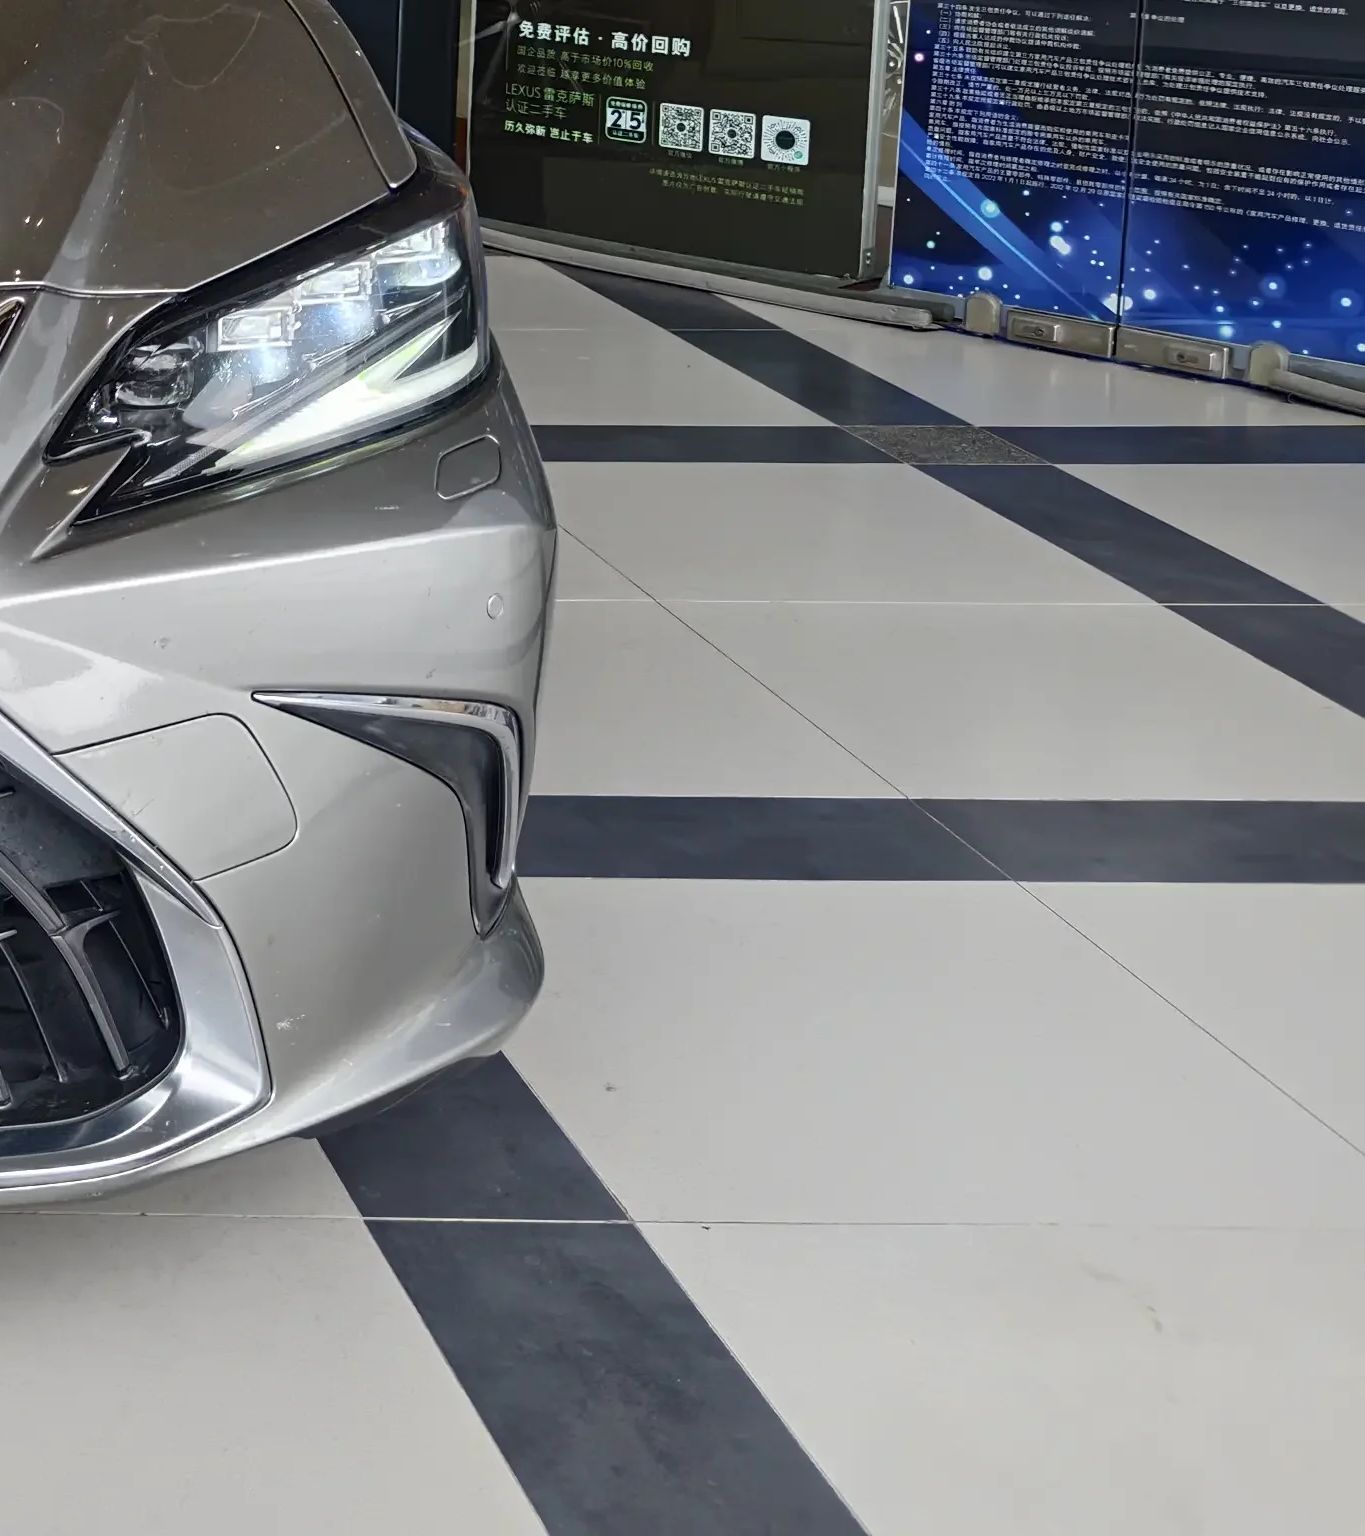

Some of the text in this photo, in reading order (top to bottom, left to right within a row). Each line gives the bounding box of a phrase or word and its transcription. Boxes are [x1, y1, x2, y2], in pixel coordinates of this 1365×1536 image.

[505, 81, 542, 100] LEXUS
[543, 86, 596, 108] 雷克萨斯
[505, 98, 567, 121] 认证二手车
[504, 119, 594, 145] 历久弥新 岂止于车
